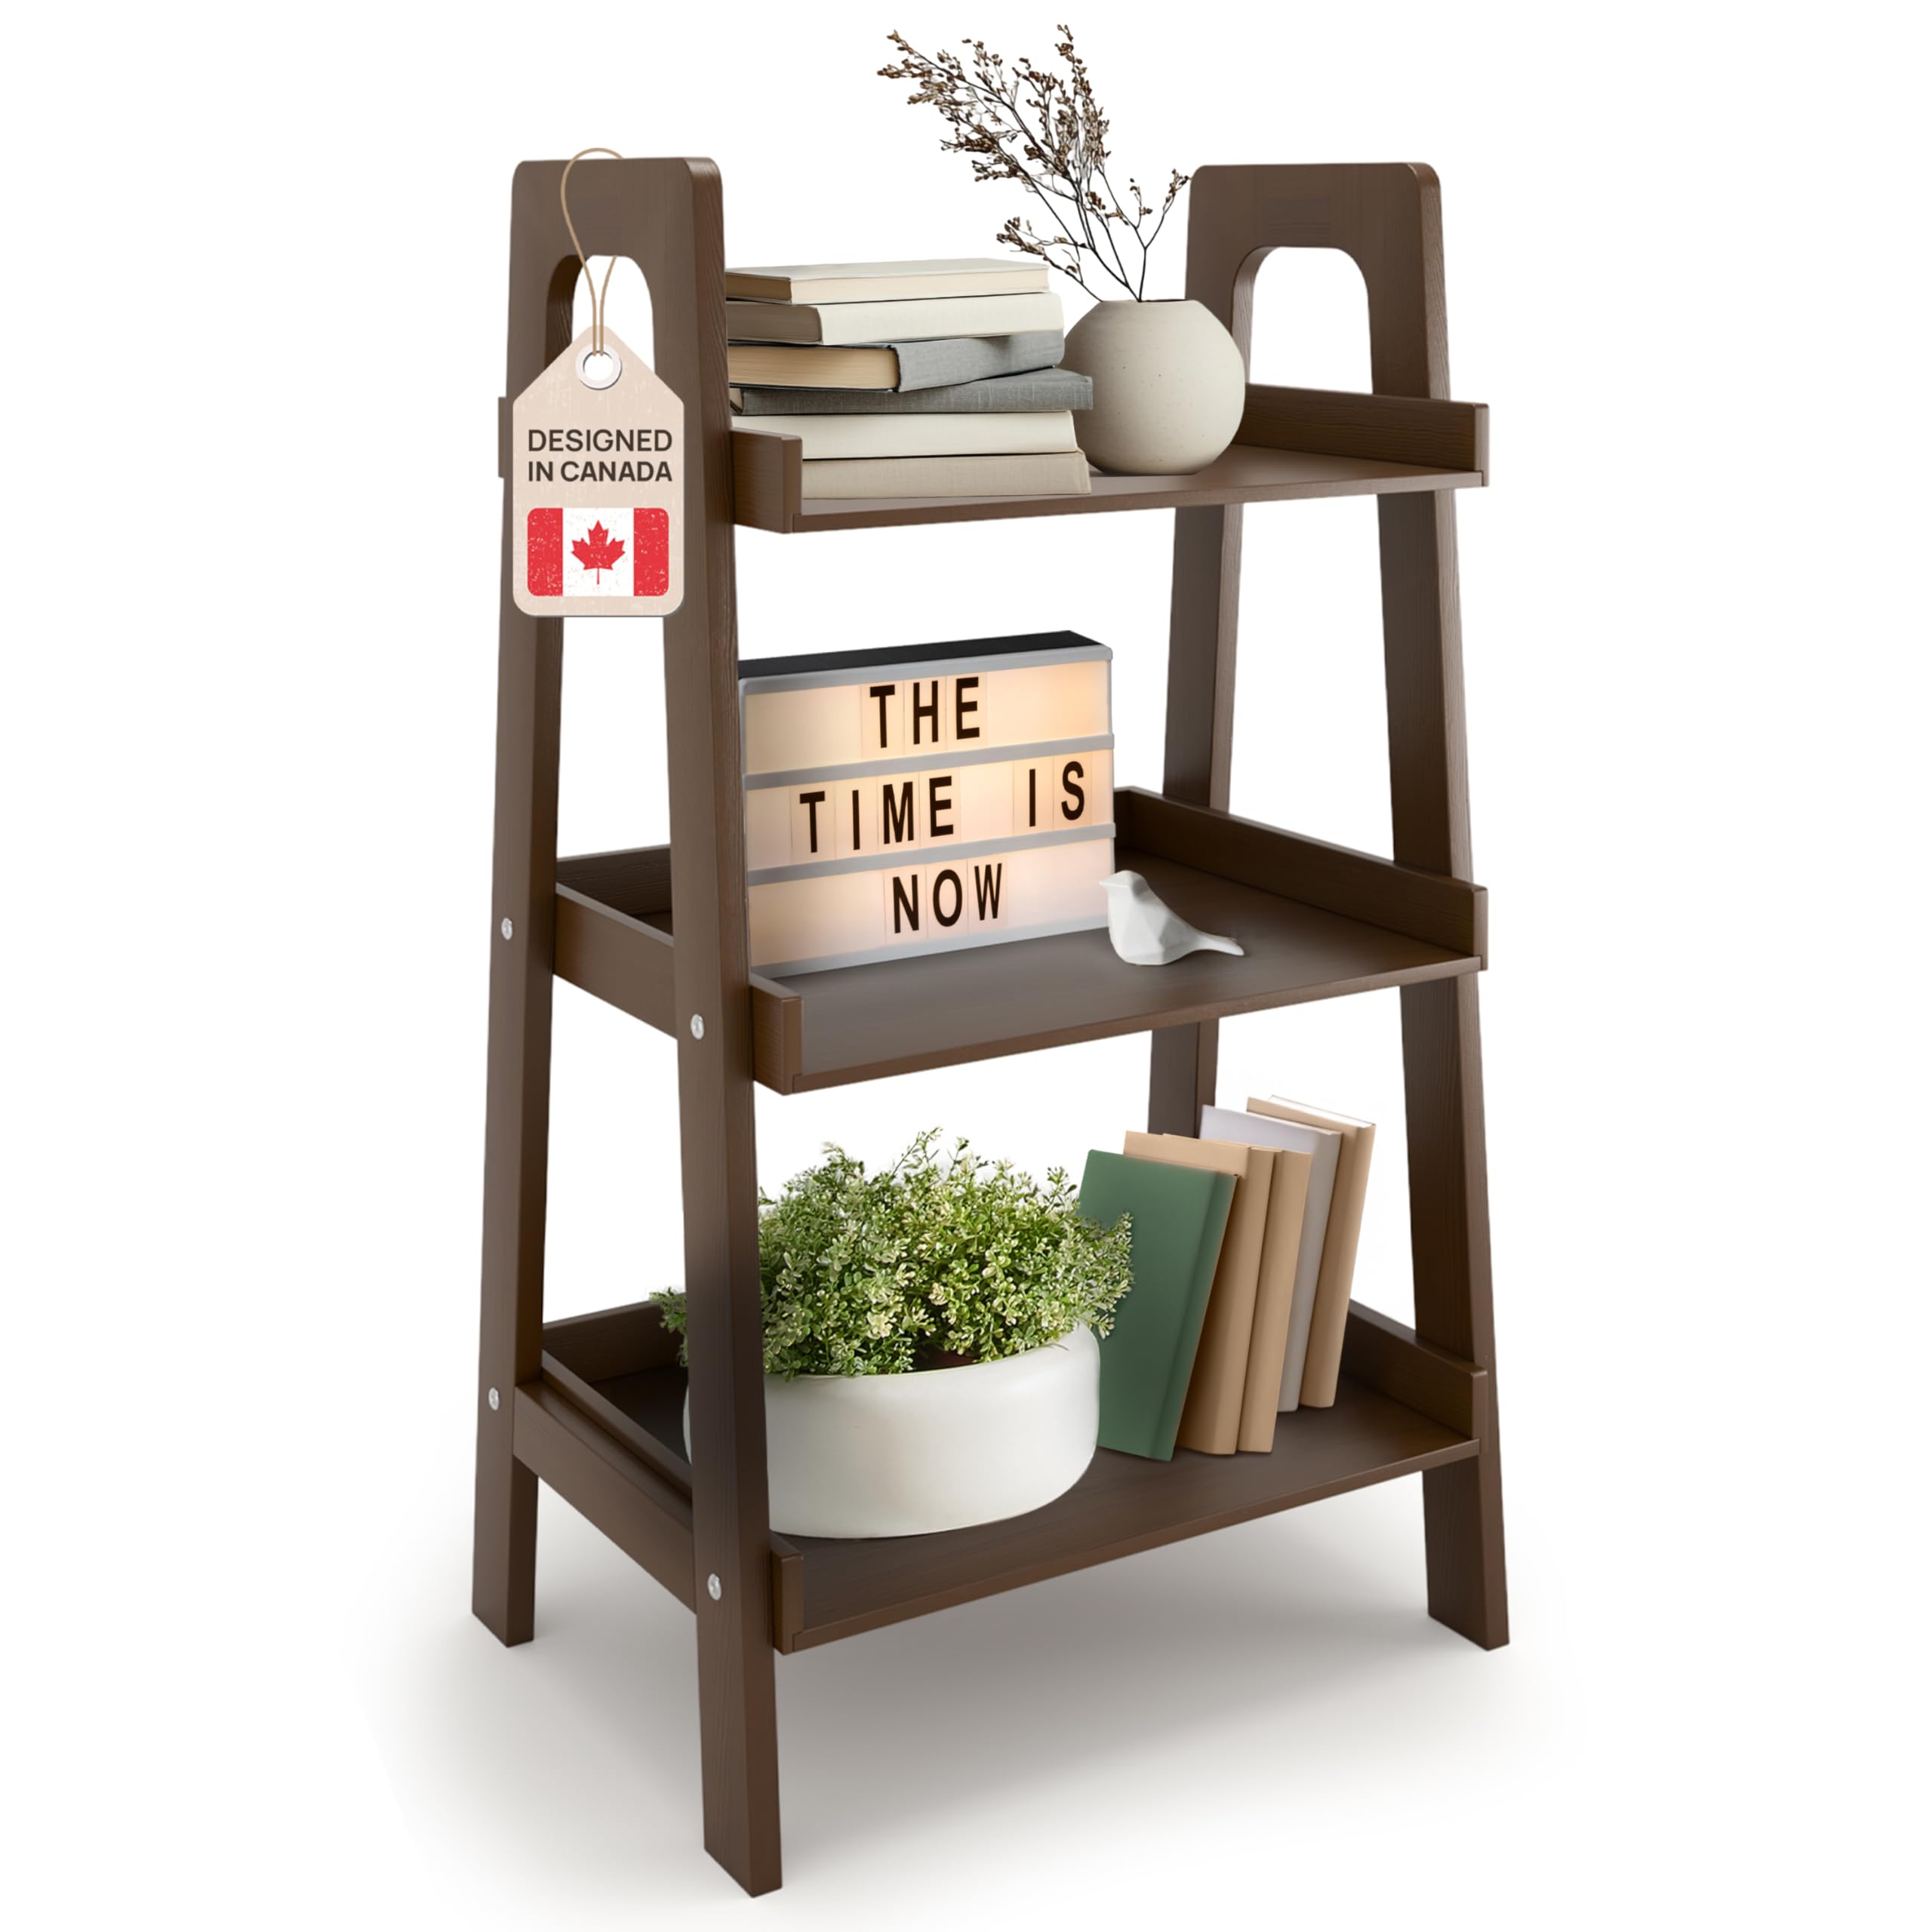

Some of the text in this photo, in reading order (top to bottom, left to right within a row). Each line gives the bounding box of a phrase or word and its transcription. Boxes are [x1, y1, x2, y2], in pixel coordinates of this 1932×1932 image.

[869, 676, 980, 749] THE
[799, 761, 1085, 854] TIME IS
[893, 863, 1002, 934] NOW
